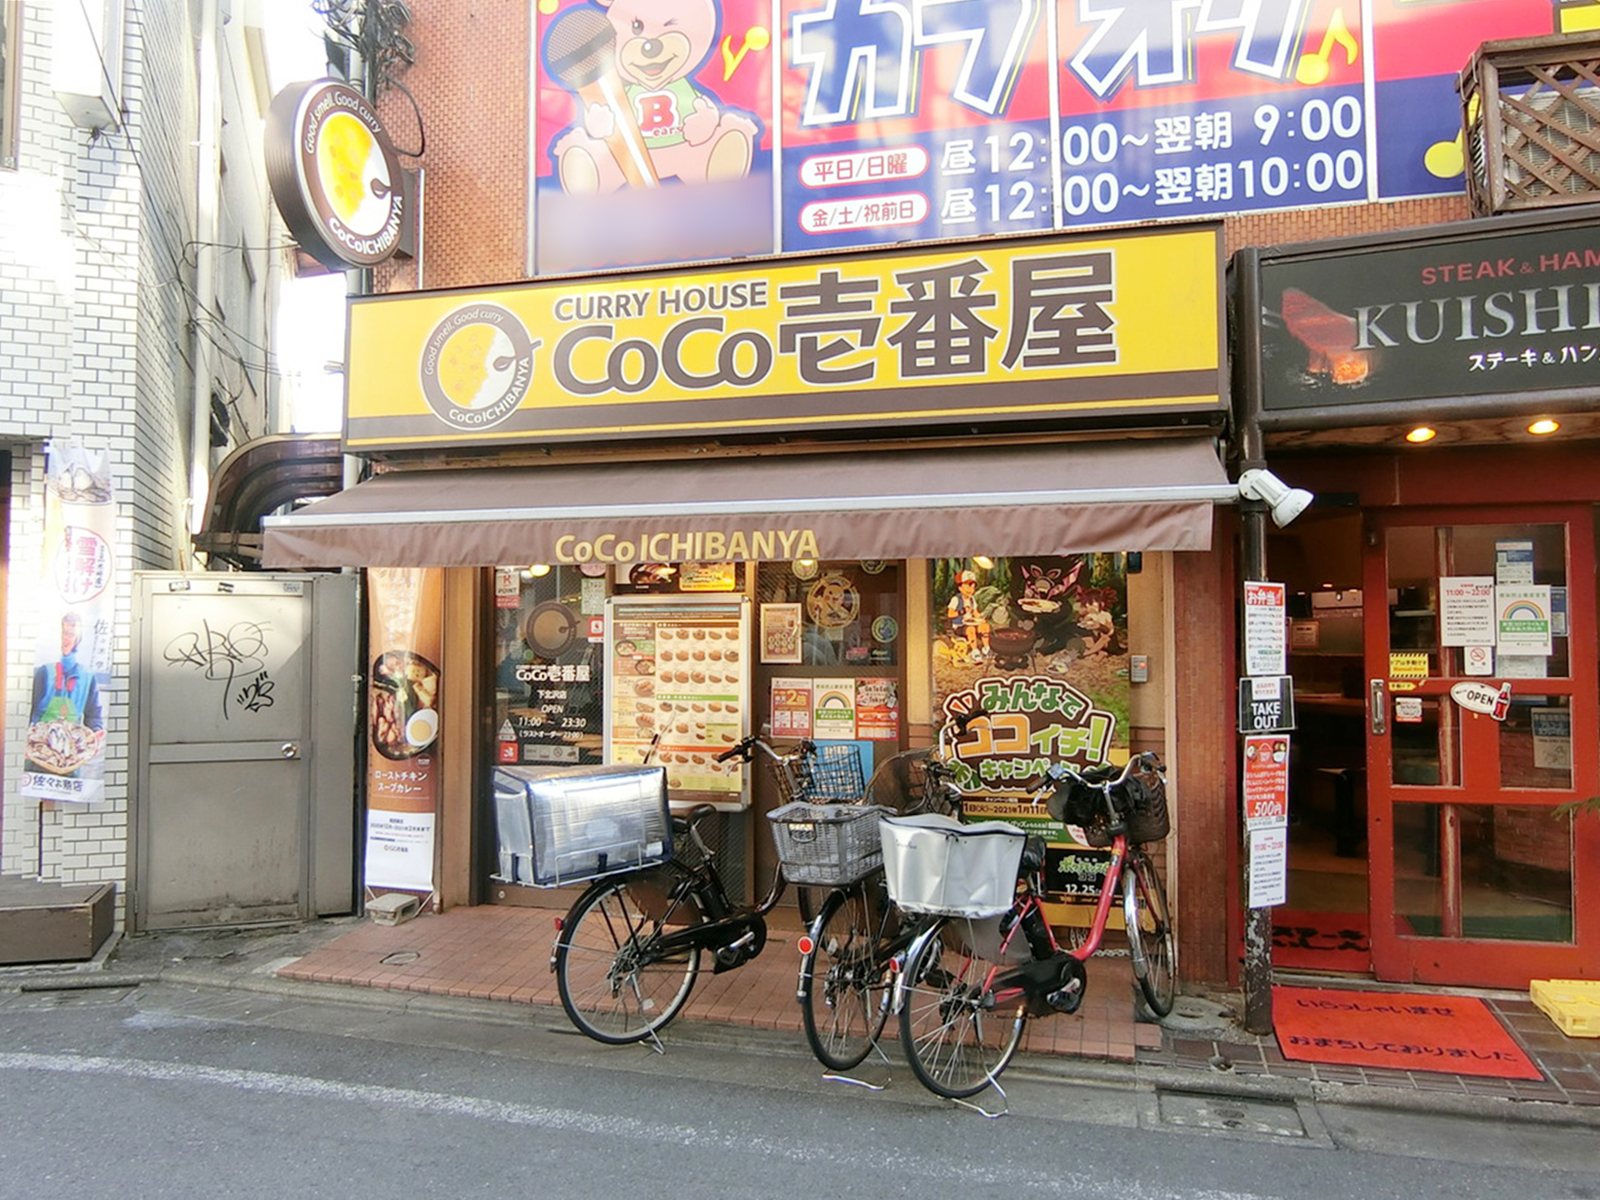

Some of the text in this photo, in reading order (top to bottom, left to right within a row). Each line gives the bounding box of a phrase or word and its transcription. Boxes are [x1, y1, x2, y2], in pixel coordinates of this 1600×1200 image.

[304, 113, 318, 154] Good
[334, 91, 360, 112] Good
[358, 106, 382, 134] curry
[813, 152, 909, 182] 平日/日曜
[811, 199, 915, 228] 金/土/祝前日
[1420, 256, 1516, 286] STEAK
[1519, 261, 1535, 275] &
[554, 280, 769, 322] CURRY HOUSE
[424, 346, 438, 376] Good
[453, 309, 480, 327] Good
[479, 309, 505, 325] curry
[541, 704, 565, 714] OPEN
[981, 683, 1084, 720] みんなで
[1251, 701, 1281, 716] TAKE
[1466, 689, 1496, 707] OPEN
[1254, 715, 1280, 729] OUT
[375, 770, 428, 782] ローストチキン
[1297, 999, 1456, 1018] いらっしゃいませ
